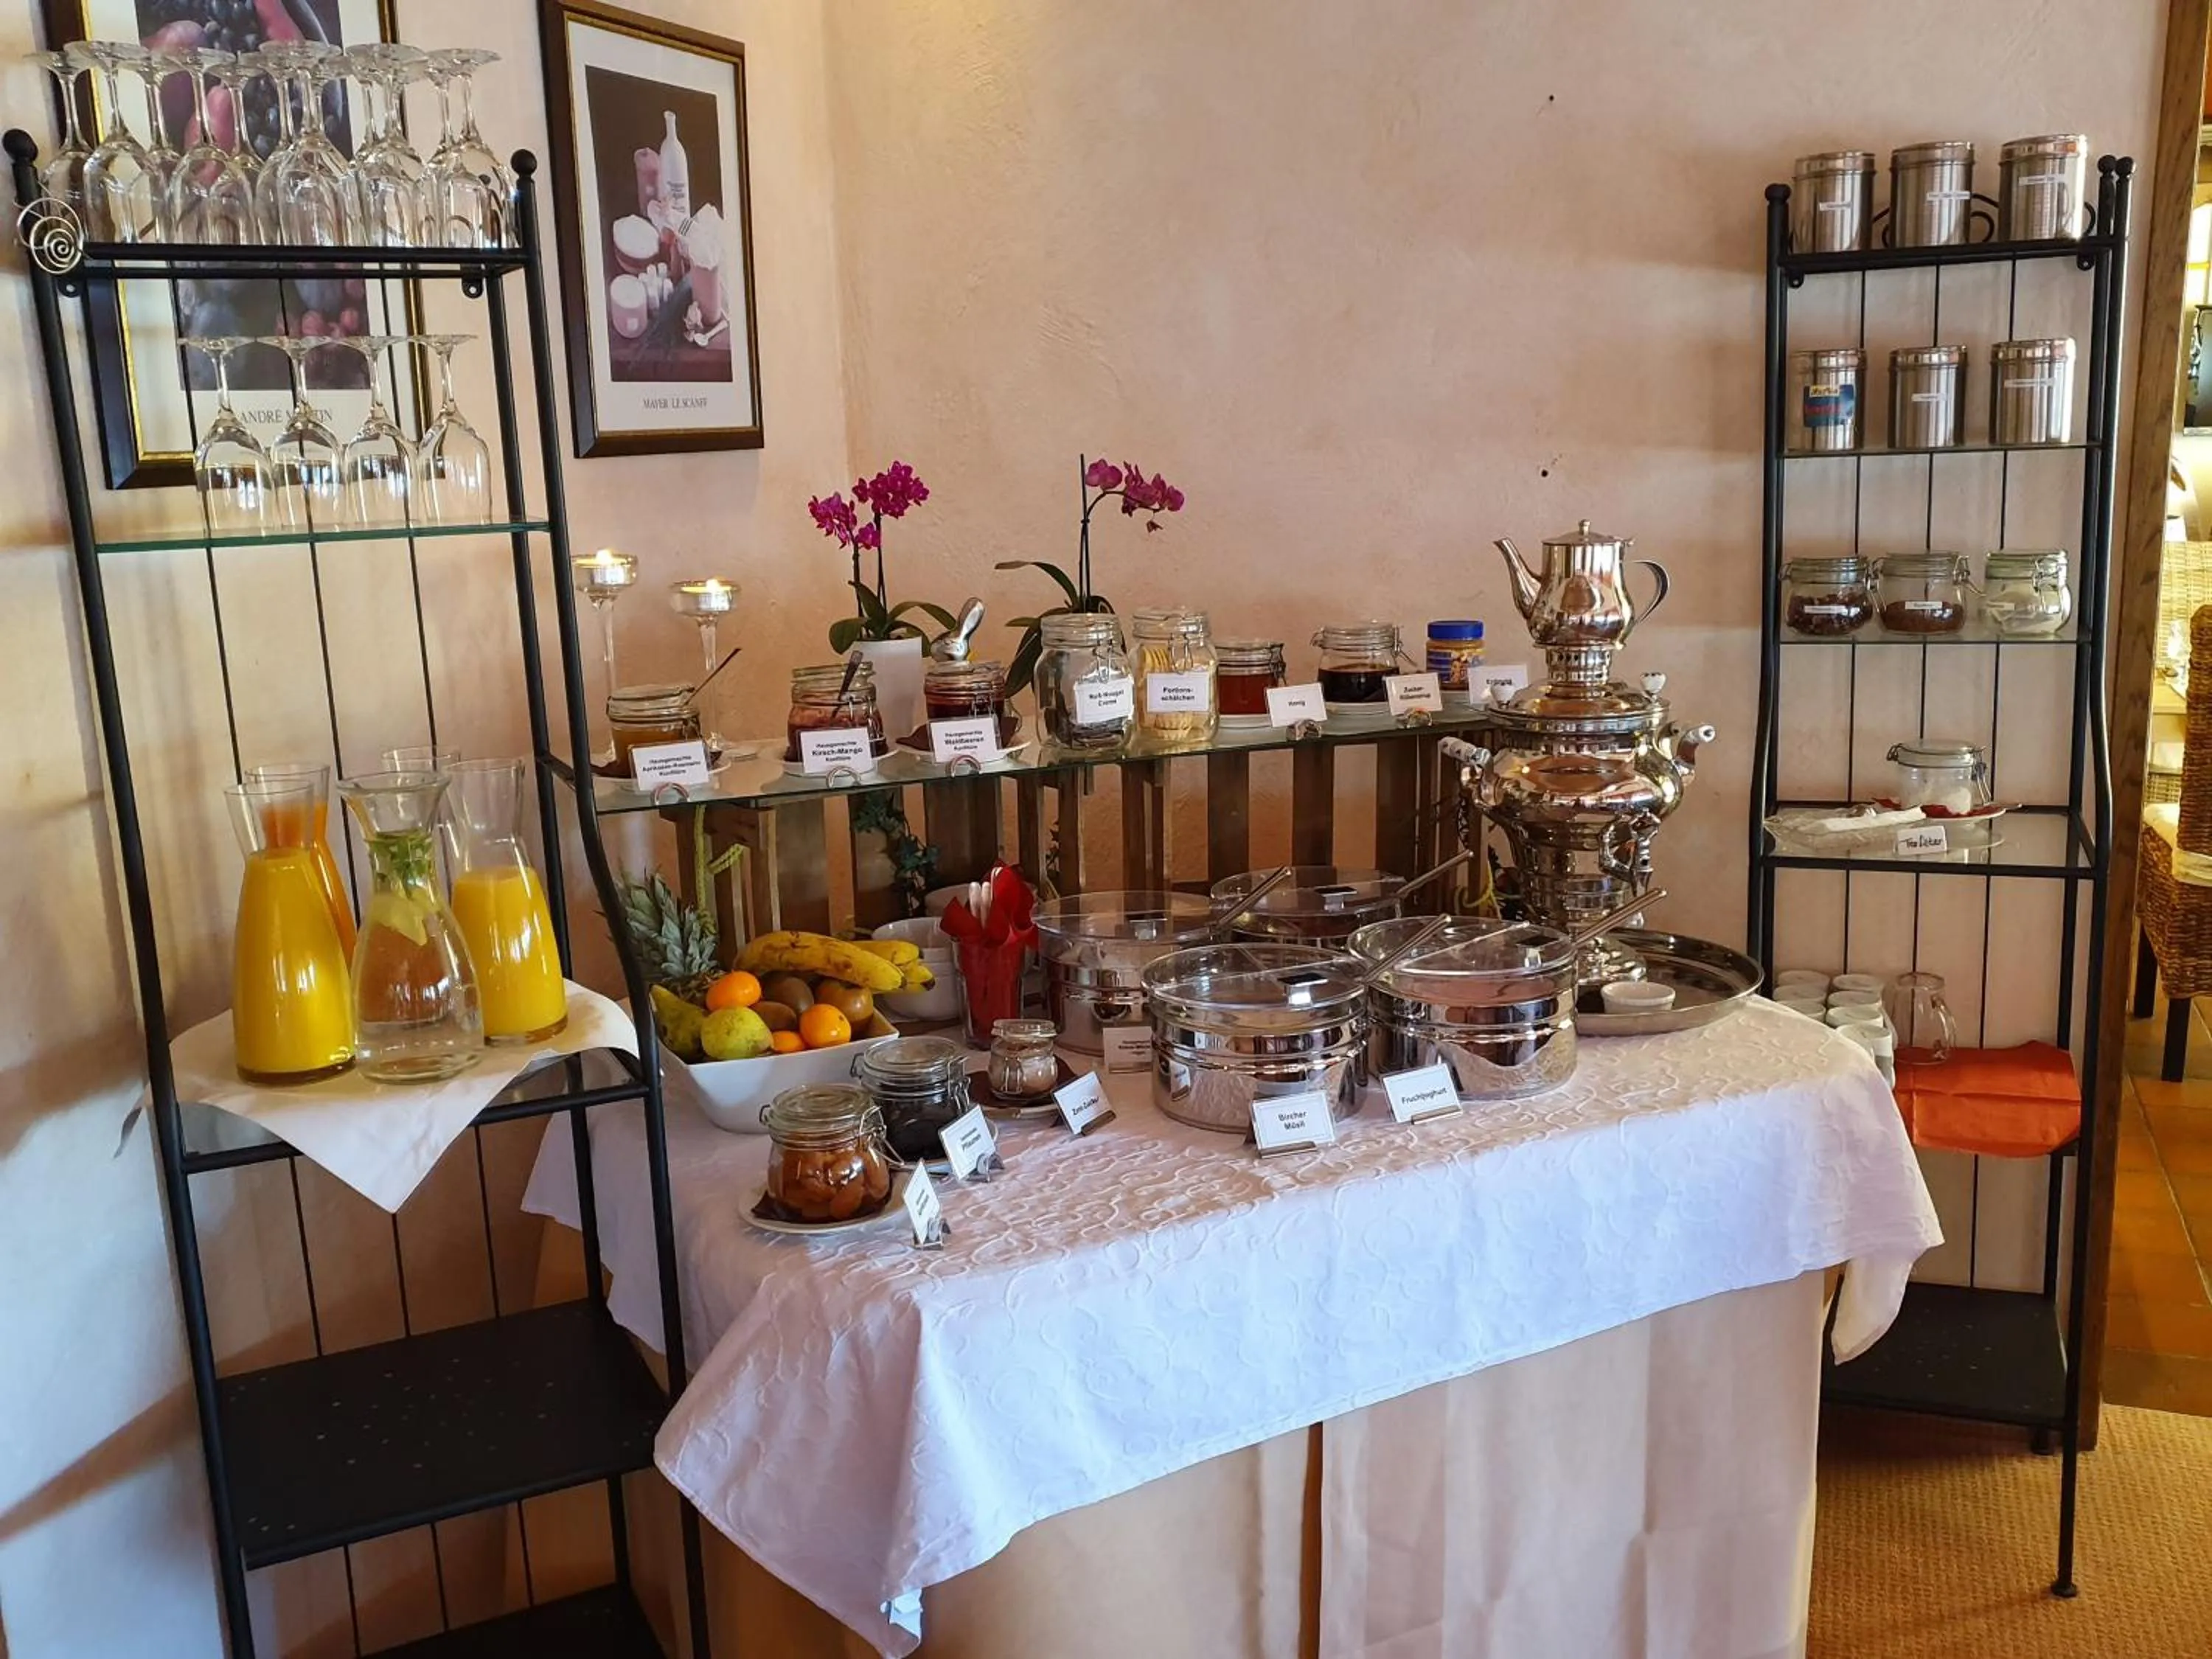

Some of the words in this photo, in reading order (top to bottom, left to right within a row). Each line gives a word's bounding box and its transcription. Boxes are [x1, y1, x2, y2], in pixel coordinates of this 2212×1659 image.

[643, 399, 668, 408] MAYER
[812, 747, 863, 756] Kirsch-Mango
[1278, 1110, 1307, 1121] Bircher
[1284, 1121, 1306, 1130] Müsli
